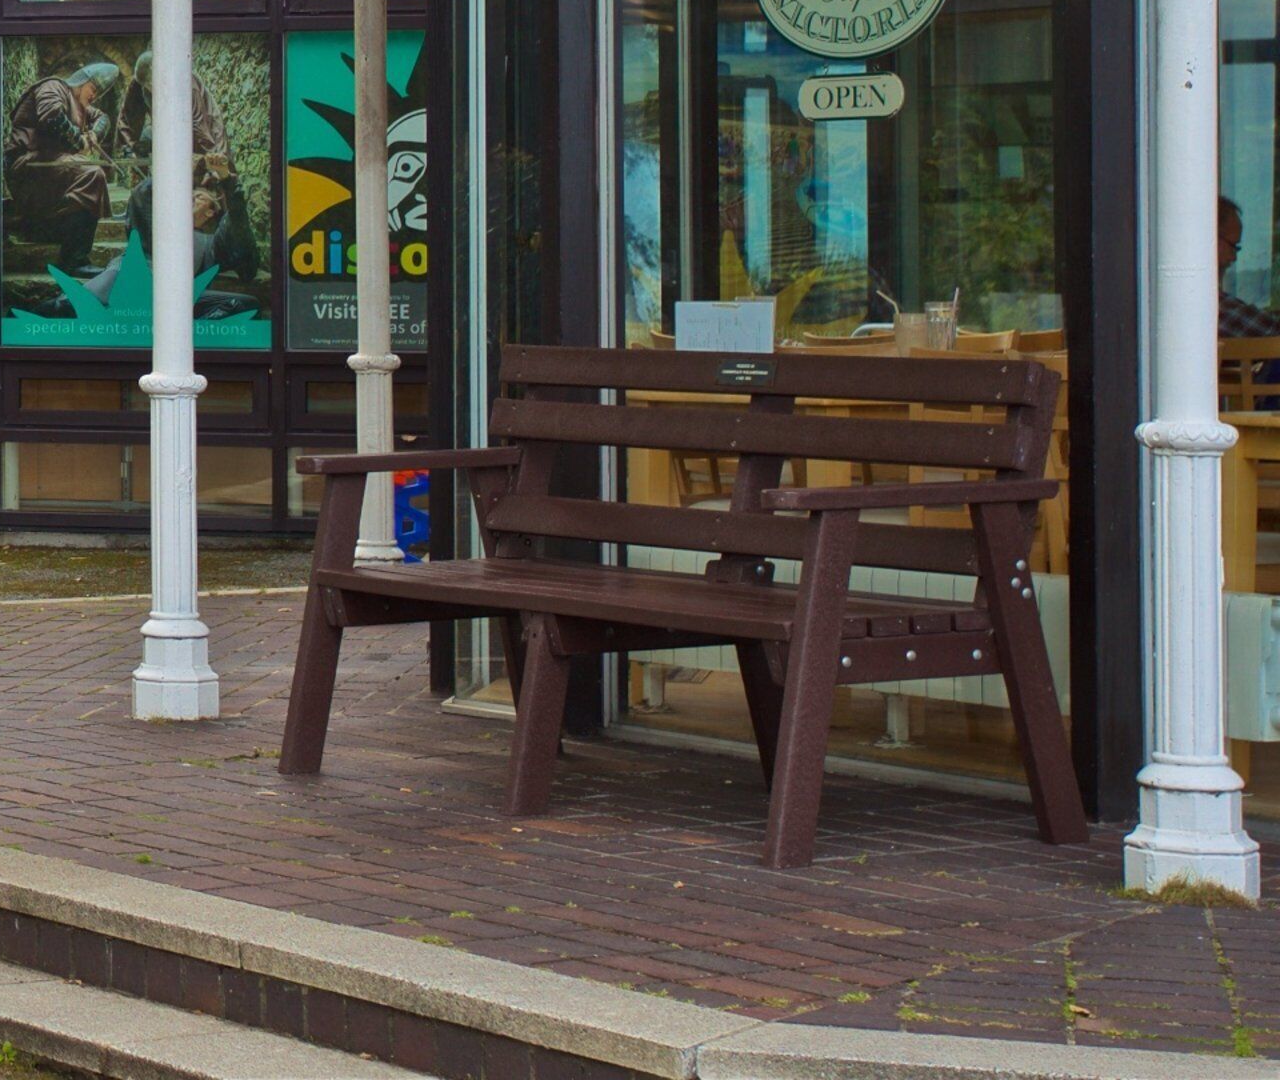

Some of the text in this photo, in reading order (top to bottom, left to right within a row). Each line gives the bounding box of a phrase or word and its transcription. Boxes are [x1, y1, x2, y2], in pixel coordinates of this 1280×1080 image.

[813, 83, 887, 110] OPEN
[313, 303, 357, 319] Visit
[24, 321, 248, 337] special events an bitions
